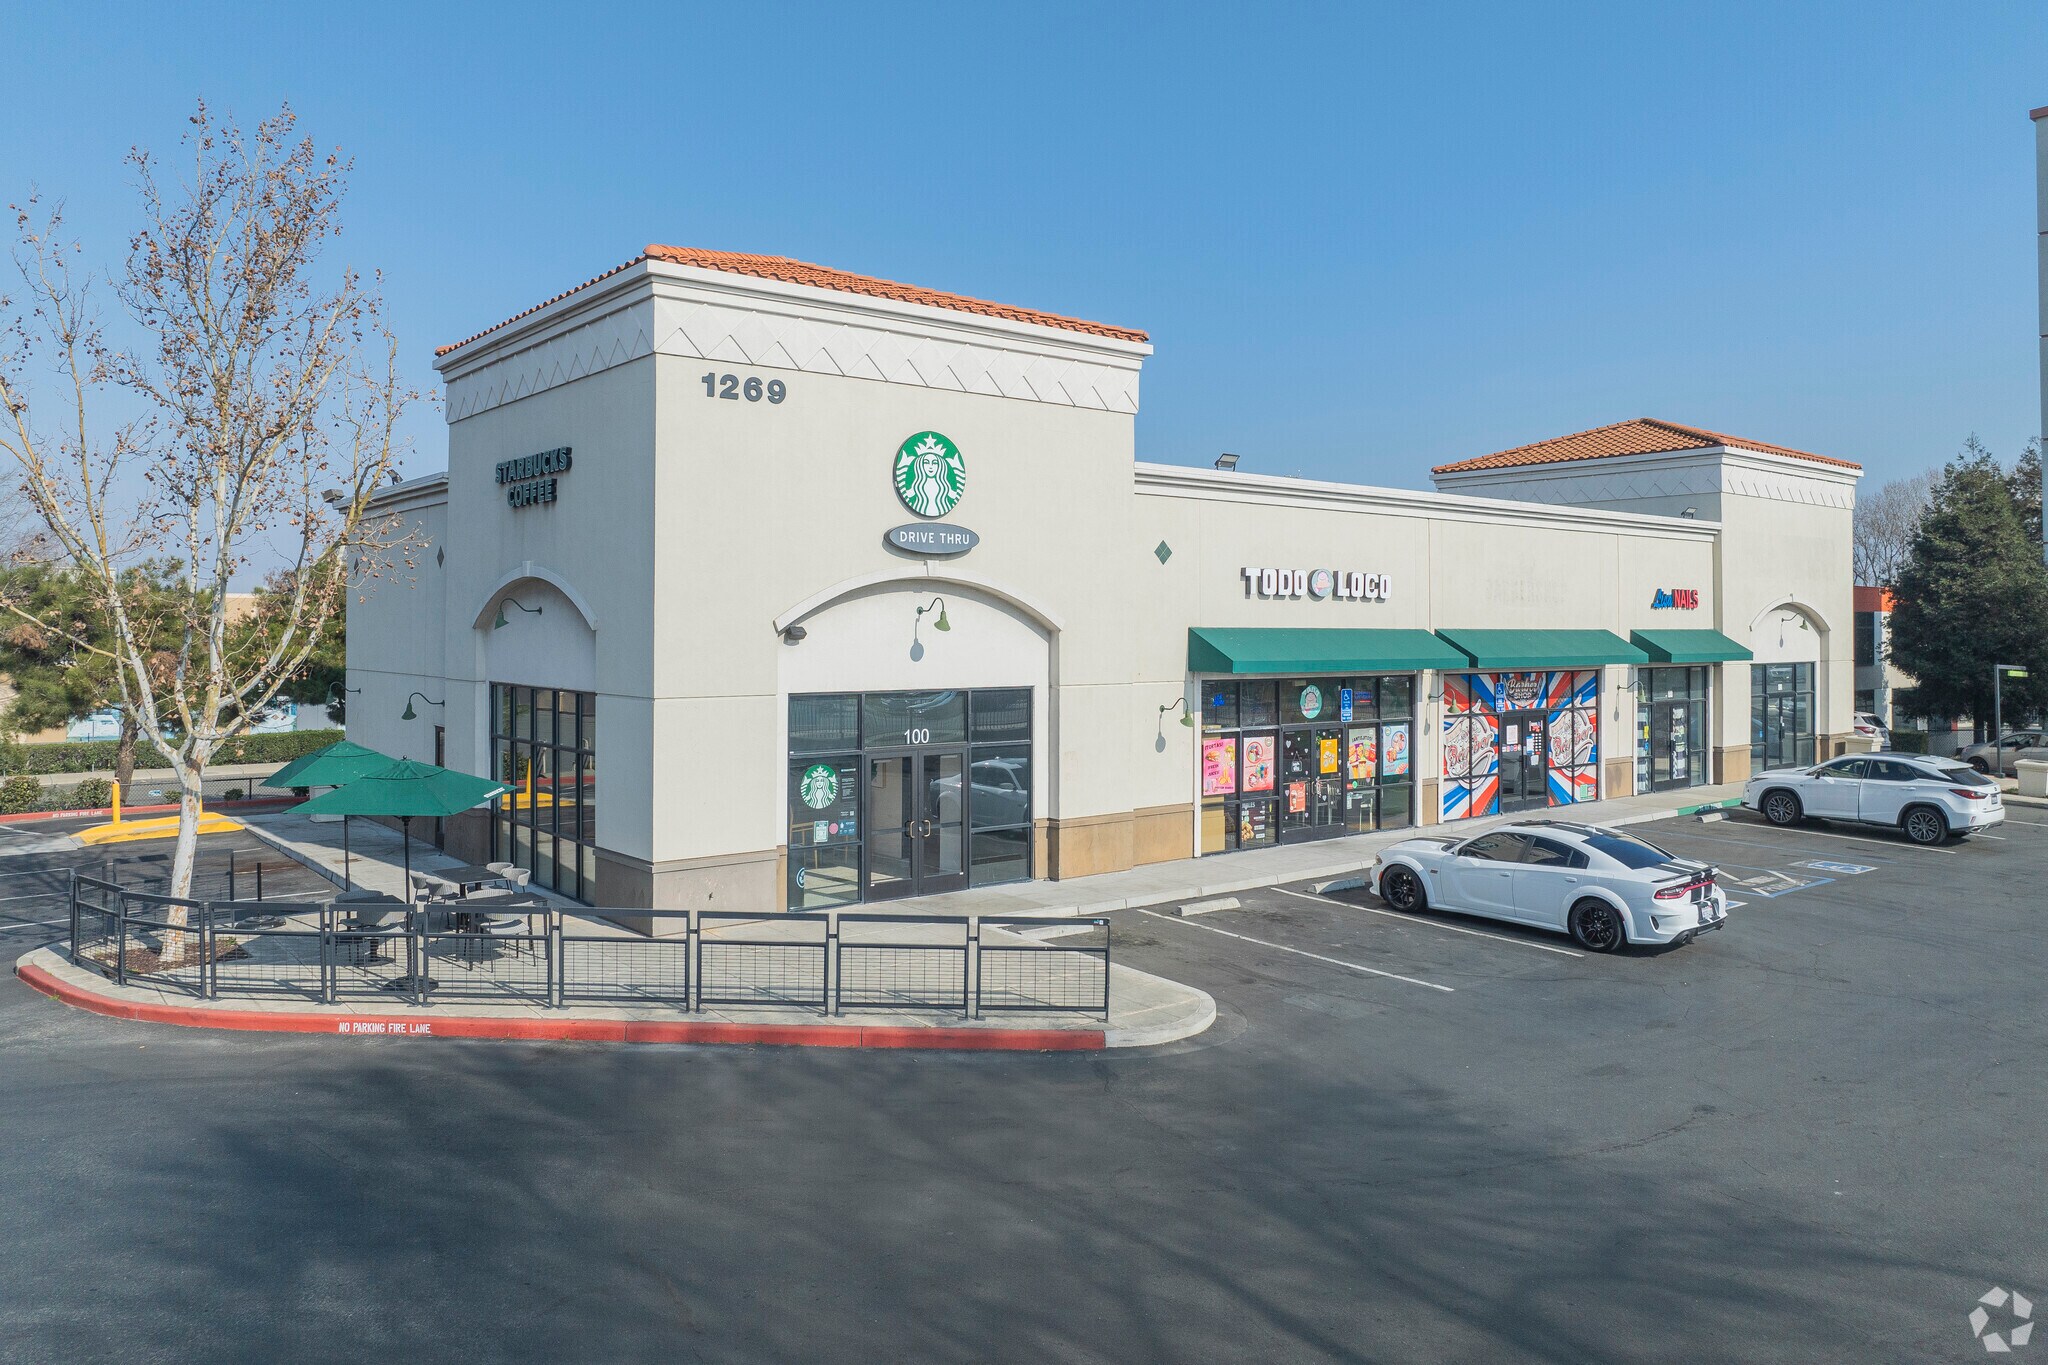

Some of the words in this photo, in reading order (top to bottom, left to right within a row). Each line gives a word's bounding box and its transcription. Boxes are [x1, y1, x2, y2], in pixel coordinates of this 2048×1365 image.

[702, 372, 786, 404] 1269
[495, 446, 572, 484] STARBUCKS
[507, 477, 557, 507] COFFEE
[900, 531, 935, 544] DRIVE
[940, 533, 970, 545] THRU
[1243, 567, 1308, 596] TODO
[1336, 570, 1392, 599] LOCO
[1673, 588, 1699, 609] NAILS
[1507, 677, 1538, 693] Barber
[904, 728, 930, 745] 100
[338, 1022, 350, 1032] NO
[353, 1022, 385, 1033] PARKING
[388, 1023, 406, 1033] FIRE
[410, 1023, 431, 1033] LANE
